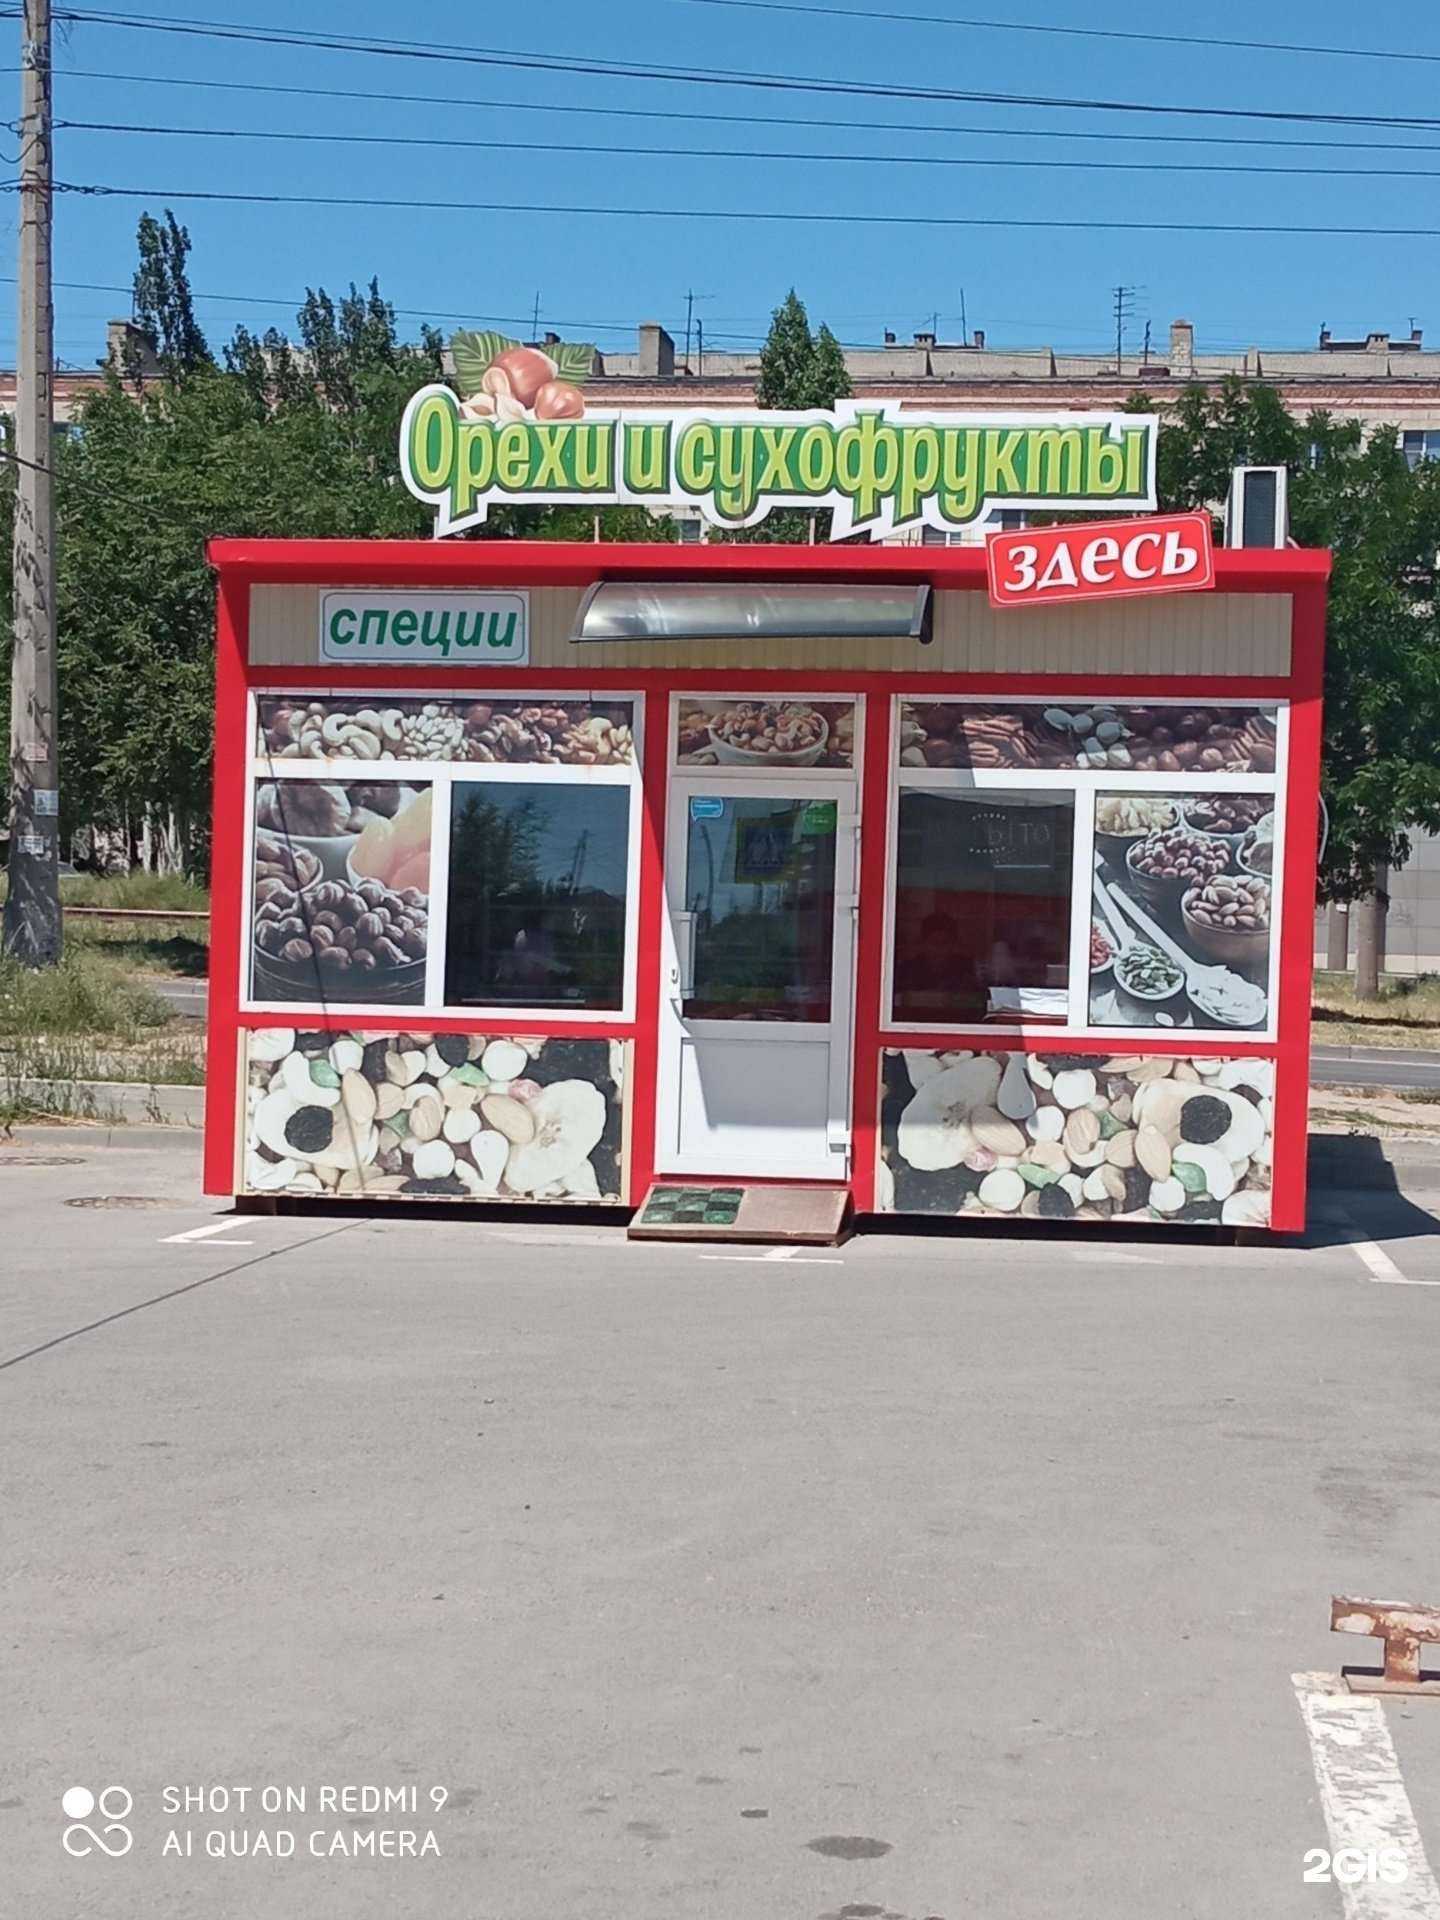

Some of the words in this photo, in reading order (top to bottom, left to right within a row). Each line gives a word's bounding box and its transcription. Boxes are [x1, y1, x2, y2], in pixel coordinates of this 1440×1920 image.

[412, 394, 614, 518] Орехи
[626, 423, 671, 491] и
[678, 409, 1147, 519] сухофрукты
[1003, 531, 1198, 592] здесь
[329, 608, 518, 657] специи
